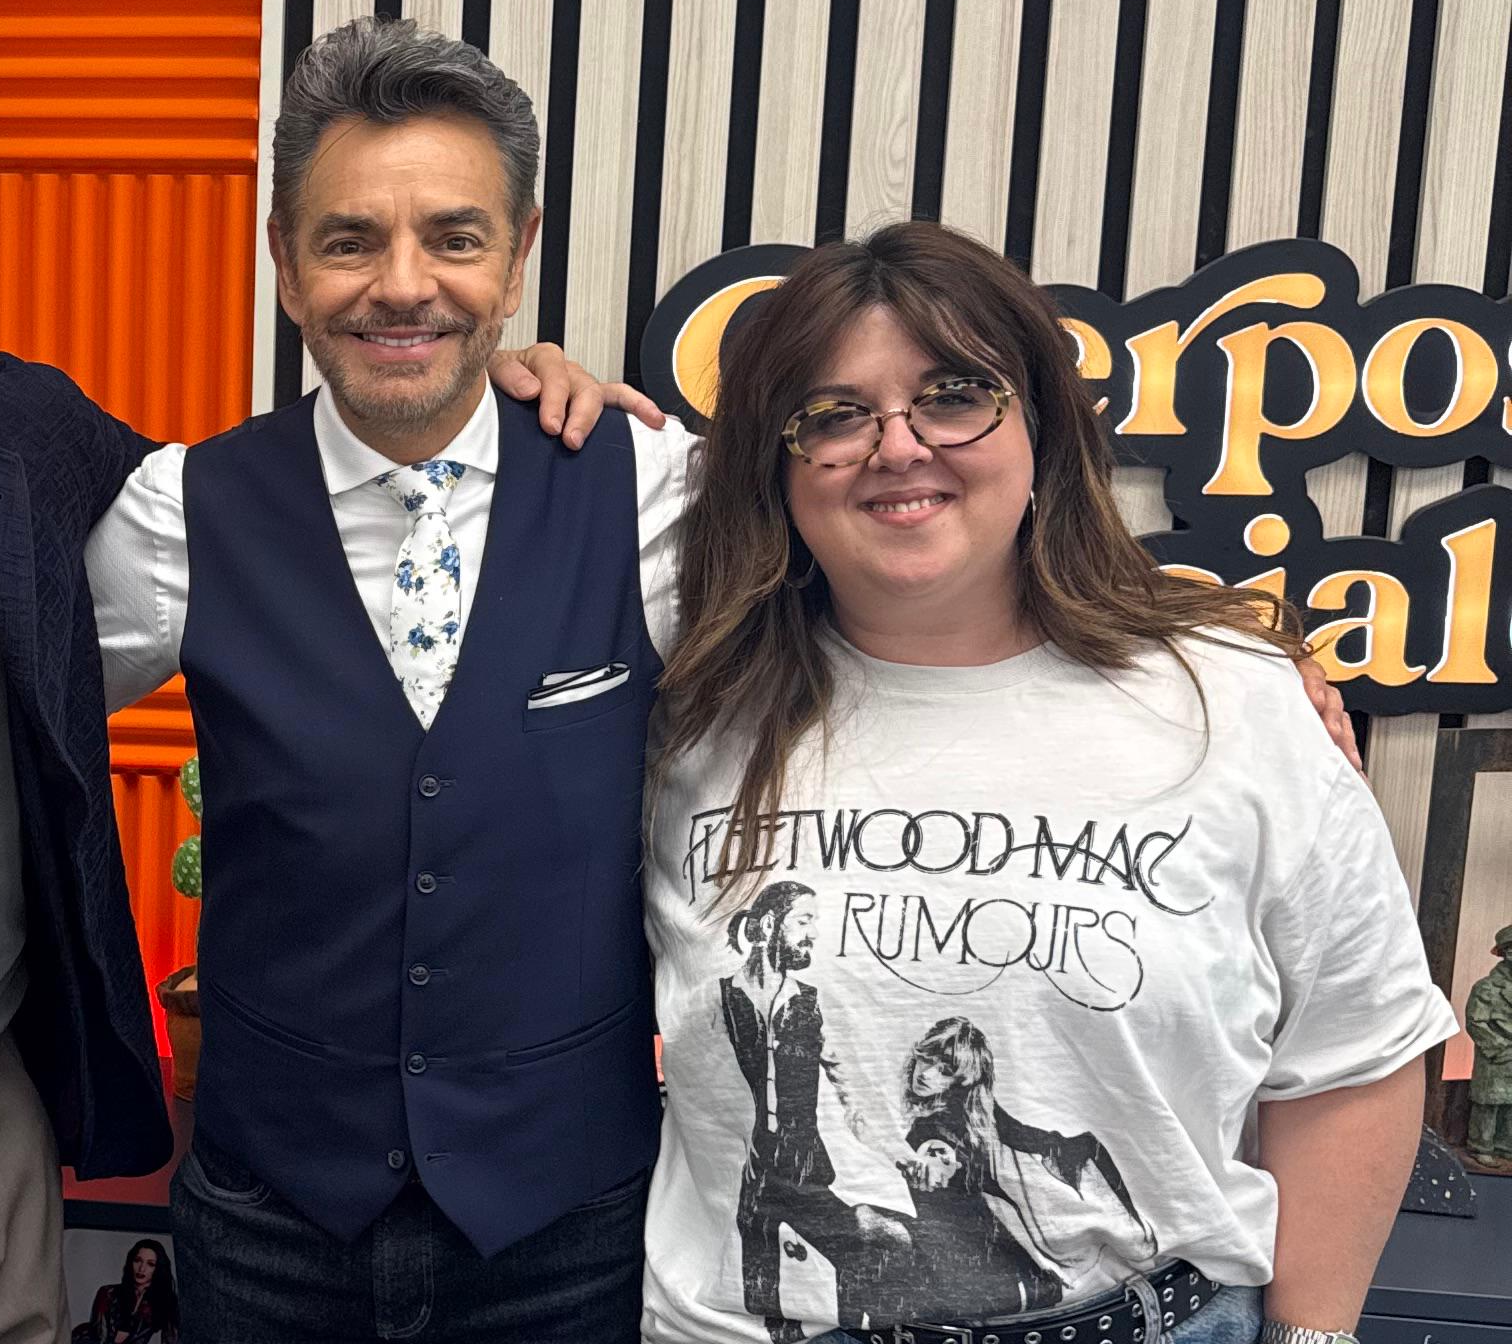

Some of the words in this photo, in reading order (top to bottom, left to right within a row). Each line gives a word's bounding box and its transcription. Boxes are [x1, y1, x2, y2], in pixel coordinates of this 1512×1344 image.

[683, 806, 1015, 906] FLEETWOOD
[1028, 813, 1217, 916] MAC
[837, 891, 1144, 1012] RUMOURS
